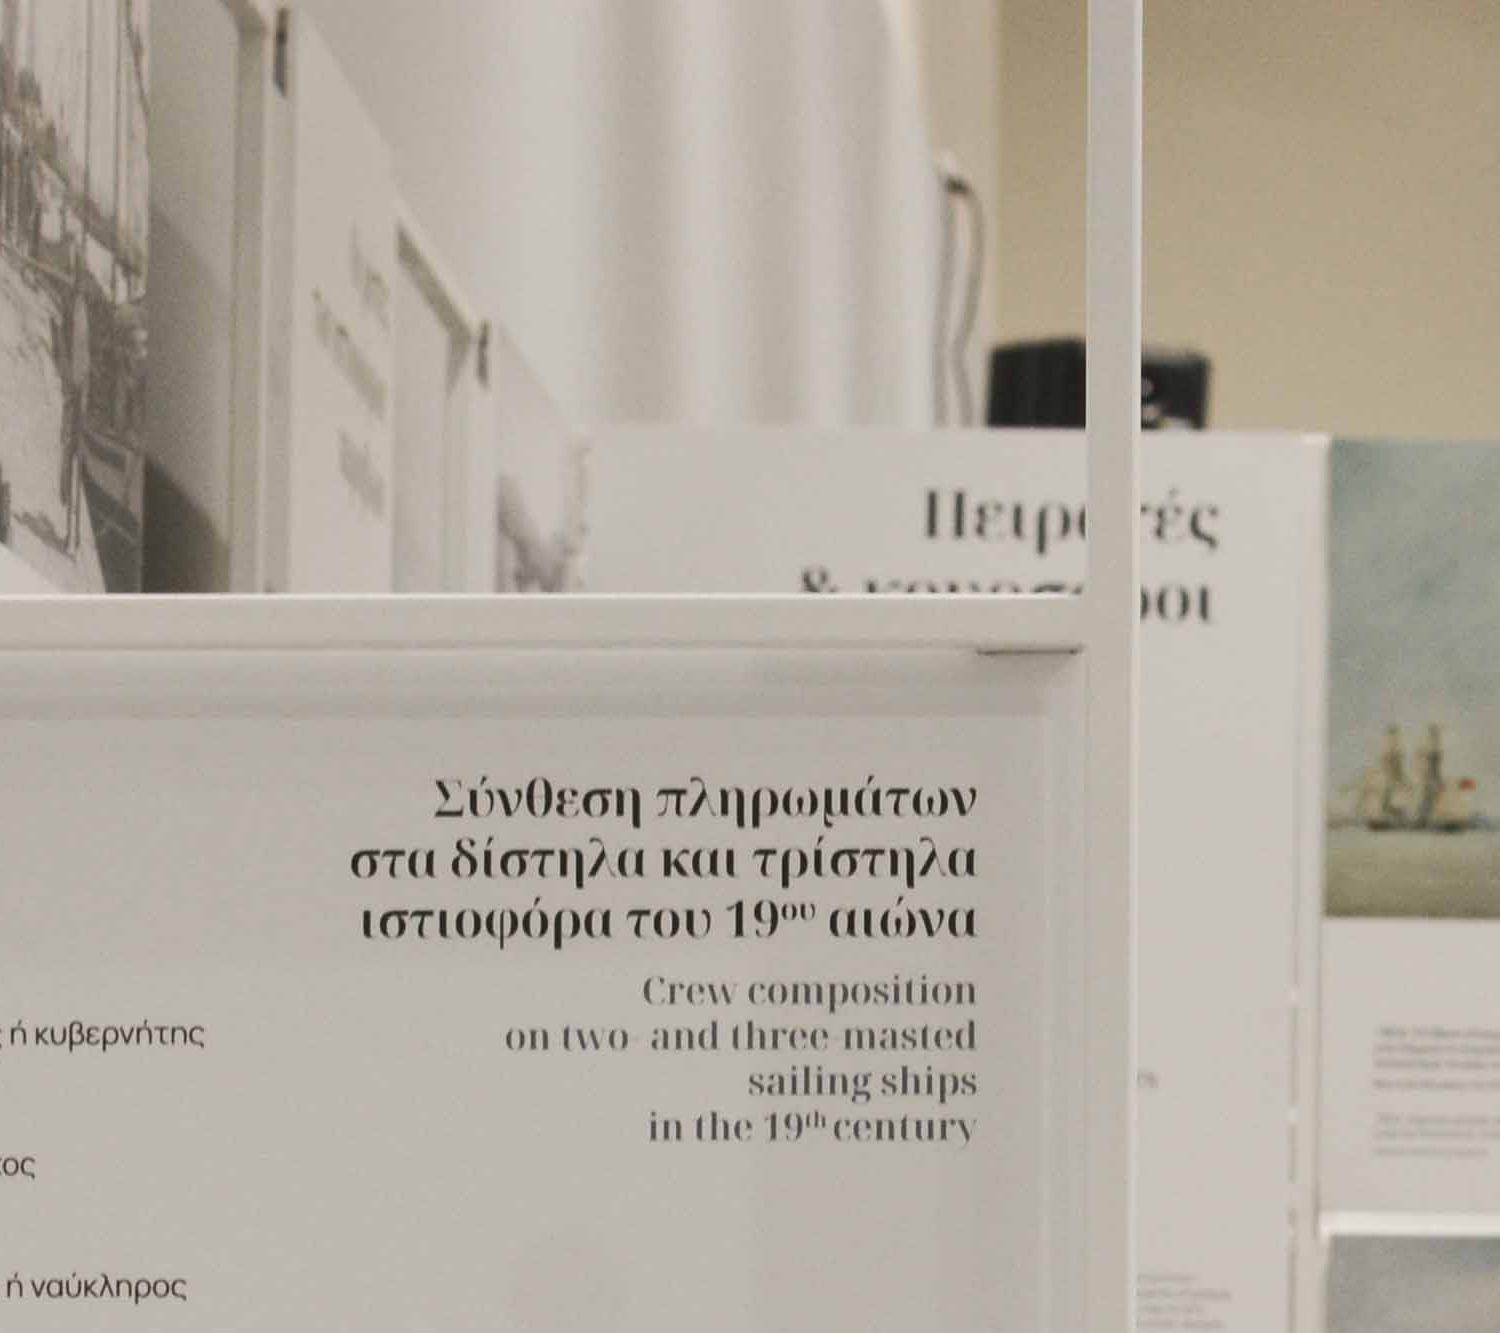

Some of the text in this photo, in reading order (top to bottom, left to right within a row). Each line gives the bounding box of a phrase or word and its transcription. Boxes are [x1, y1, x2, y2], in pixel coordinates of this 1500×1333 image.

[435, 775, 977, 829] Σύνθεση πληρωμάτων
[351, 836, 975, 889] στα δίστηλα και τρίστηλα
[363, 897, 611, 950] ιστιοφόρα
[627, 909, 711, 938] του
[830, 896, 975, 937] αιώνα
[642, 974, 975, 1014] Crew composition
[10, 1020, 27, 1045] ή
[35, 1019, 204, 1053] κυβερνήτης
[504, 1028, 548, 1051] on
[649, 1019, 718, 1051] and
[749, 1065, 977, 1104] sailing ships
[650, 1111, 682, 1141] in
[696, 1111, 752, 1141] the
[833, 1112, 977, 1146] century
[7, 1272, 23, 1298] ή
[31, 1272, 187, 1305] ναύκληρος
